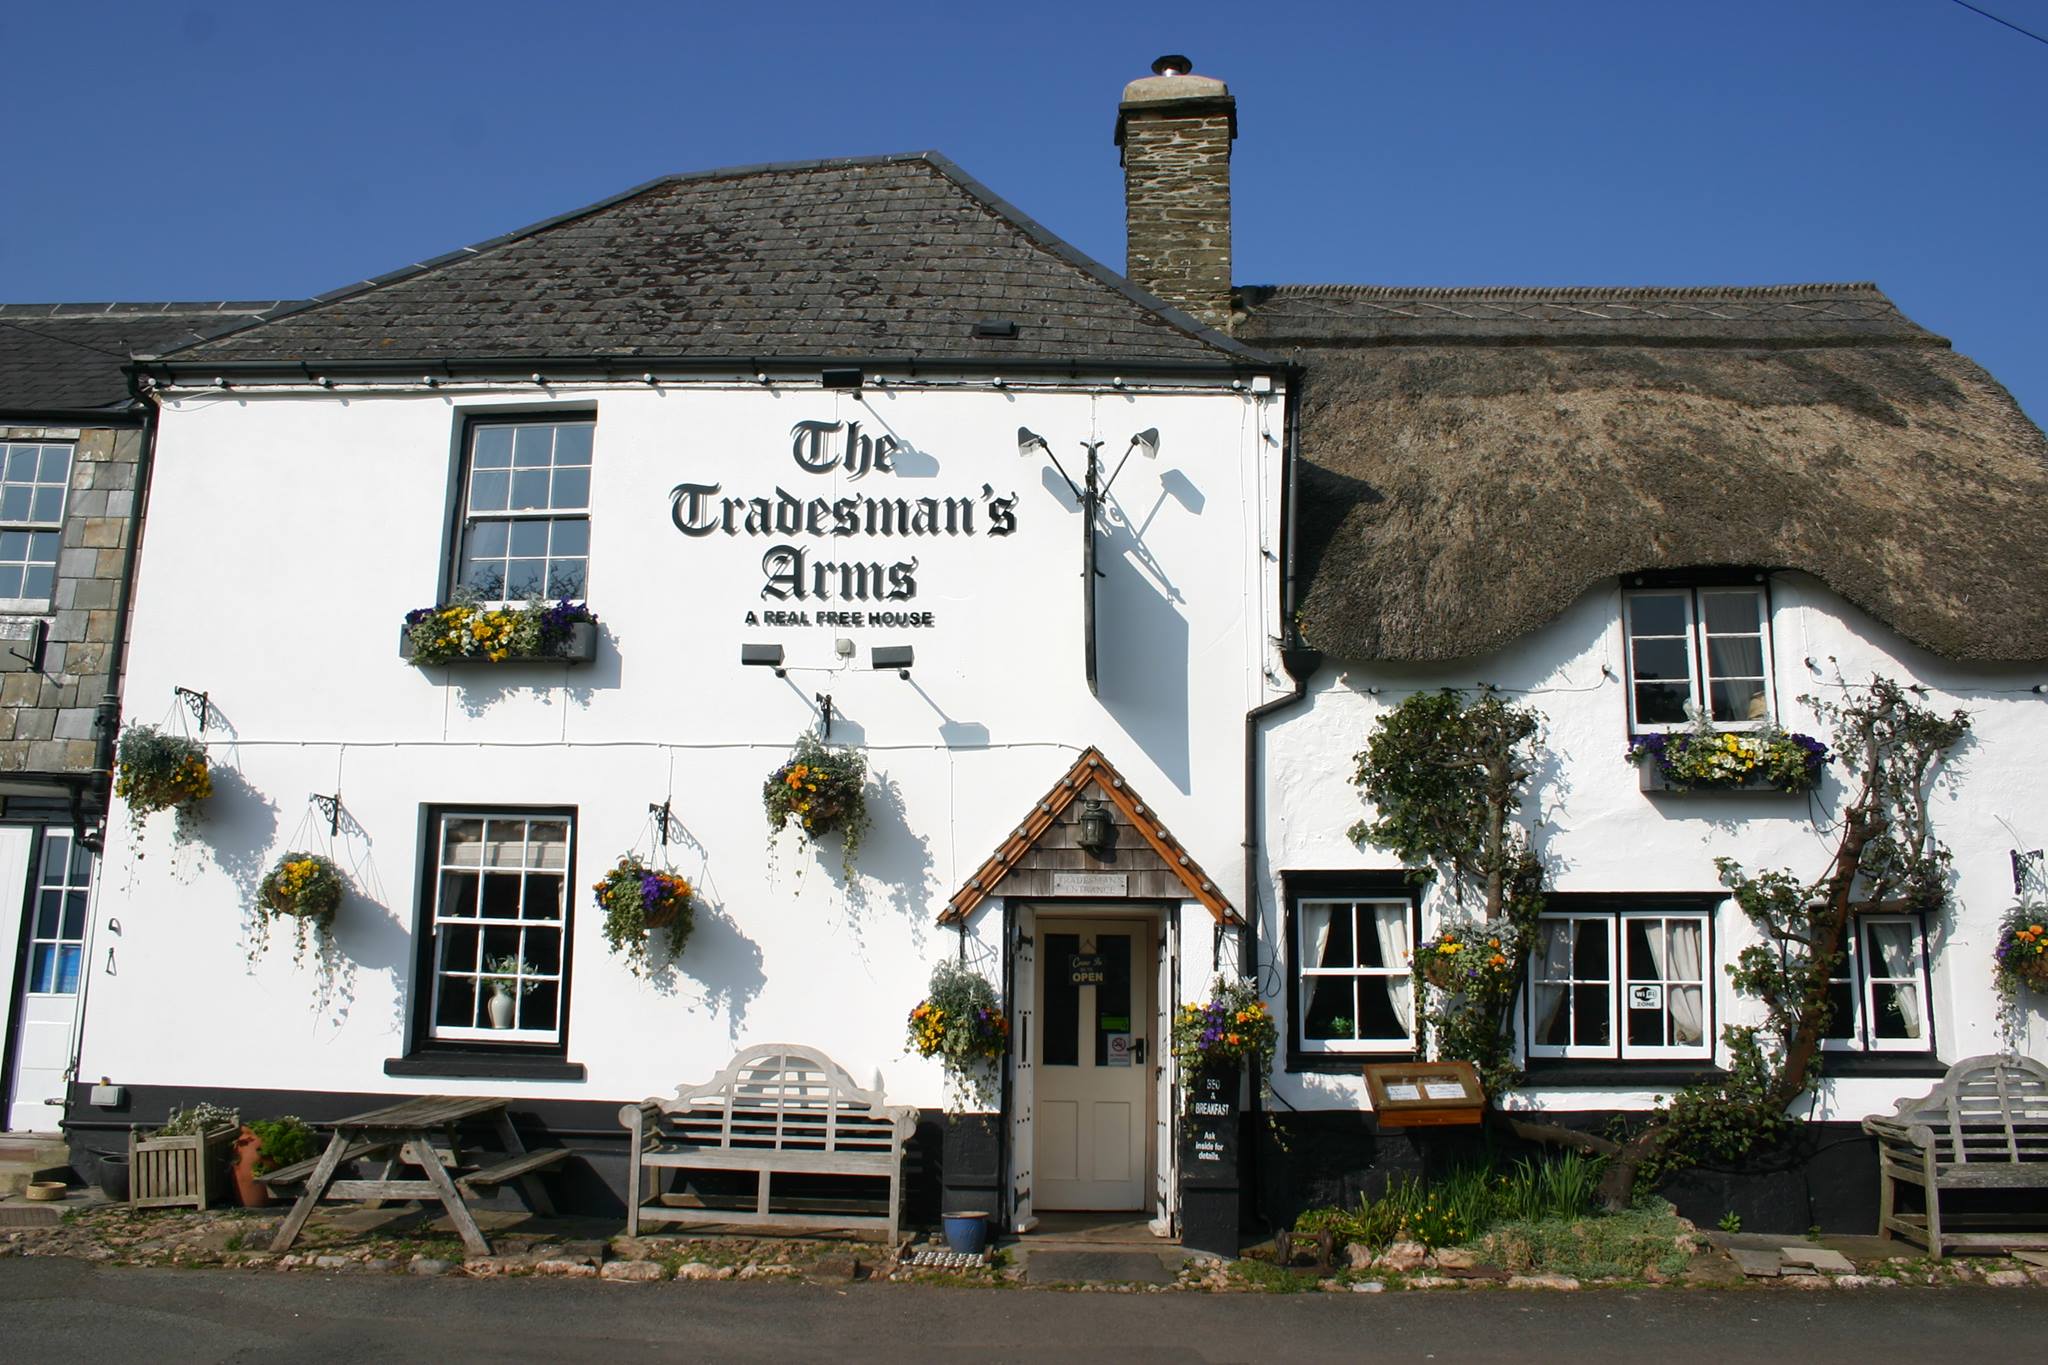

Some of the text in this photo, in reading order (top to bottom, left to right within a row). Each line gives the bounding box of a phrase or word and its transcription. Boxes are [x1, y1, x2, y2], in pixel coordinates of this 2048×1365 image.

[790, 419, 899, 481] The
[669, 482, 1019, 538] Tradesman's
[761, 544, 919, 602] Arms
[745, 610, 934, 627] A REAL FREE HOUSE
[1072, 971, 1104, 982] OPEN
[1195, 1102, 1230, 1116] BREAKFAST
[1204, 1131, 1216, 1140] Ask
[1215, 1142, 1224, 1152] for
